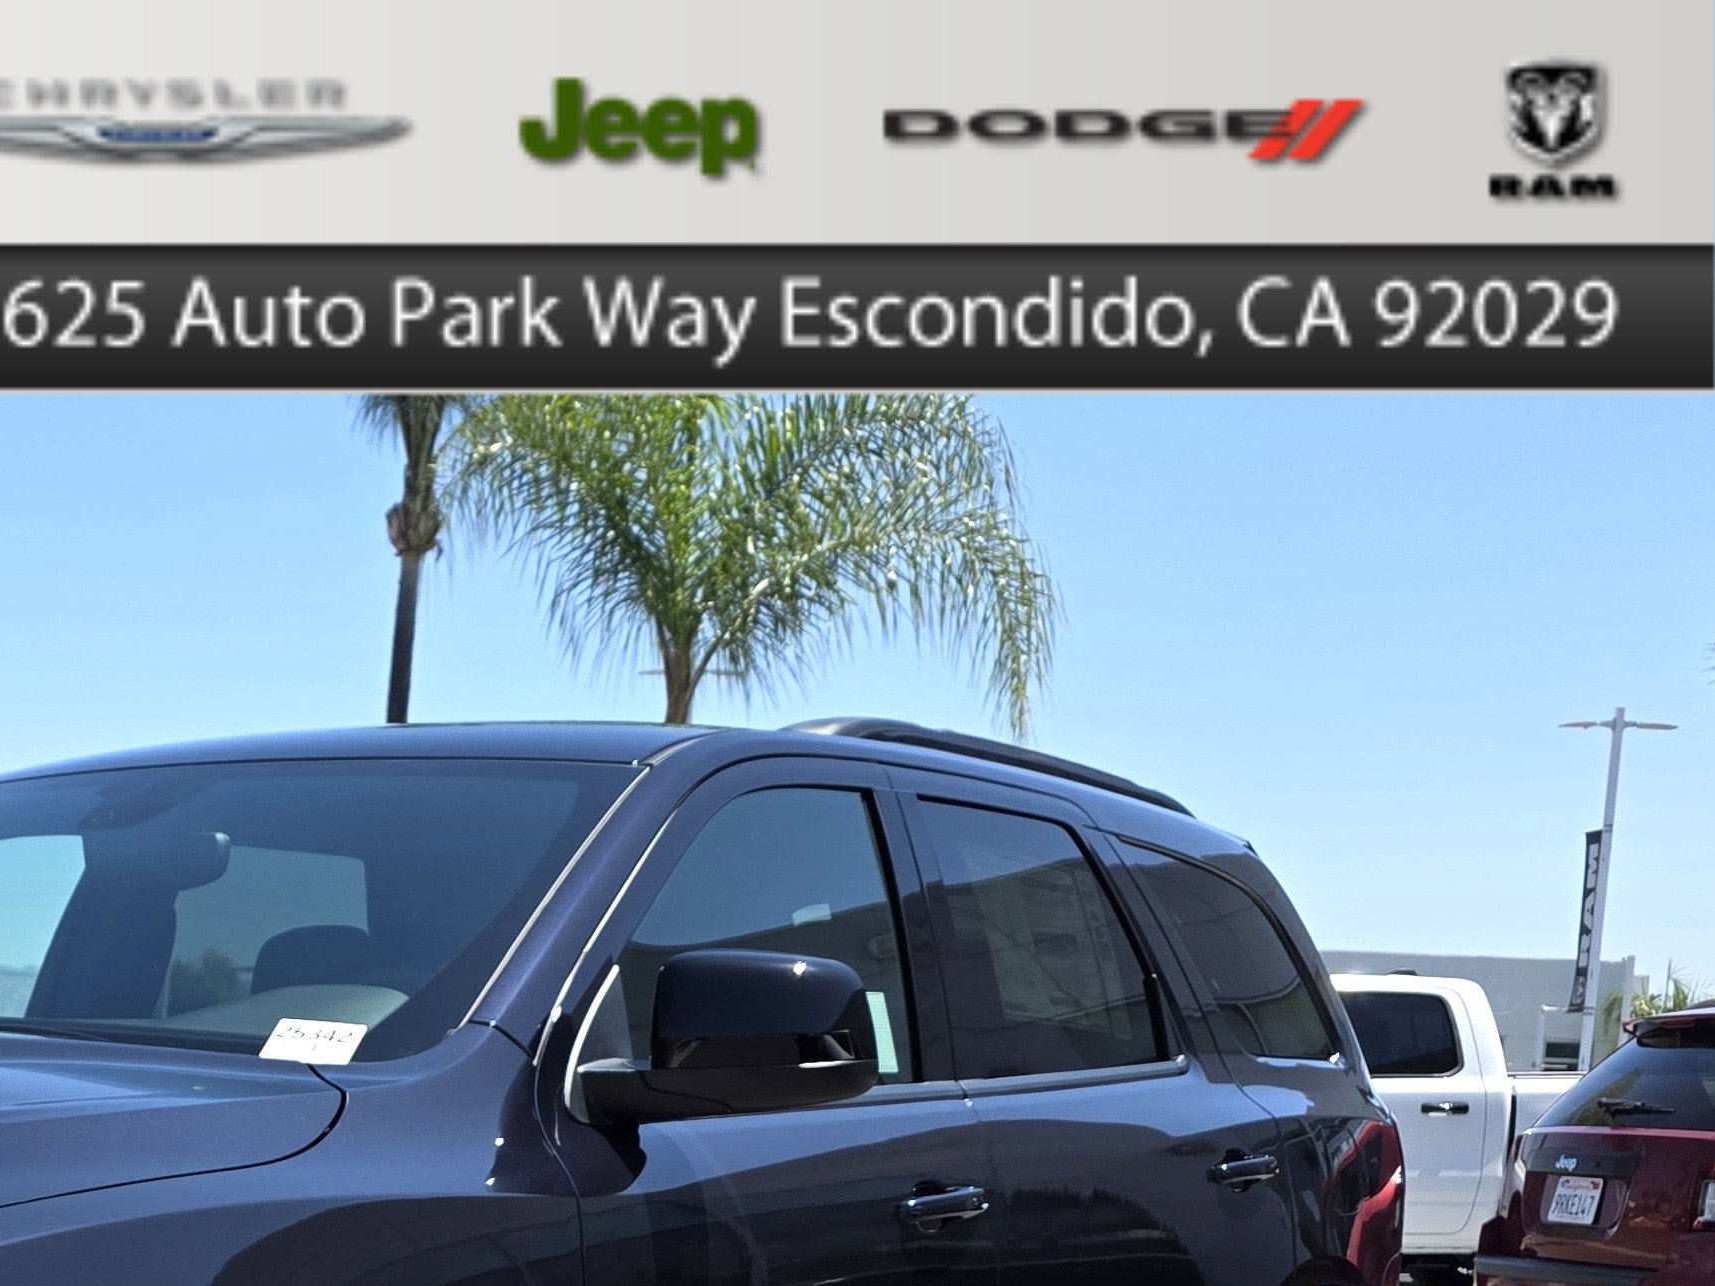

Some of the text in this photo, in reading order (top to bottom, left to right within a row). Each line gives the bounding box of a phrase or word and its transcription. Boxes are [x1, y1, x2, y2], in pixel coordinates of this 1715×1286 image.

[1577, 842, 1600, 968] RAM
[276, 1026, 354, 1043] 25342
[1554, 1153, 1578, 1173] Jeep
